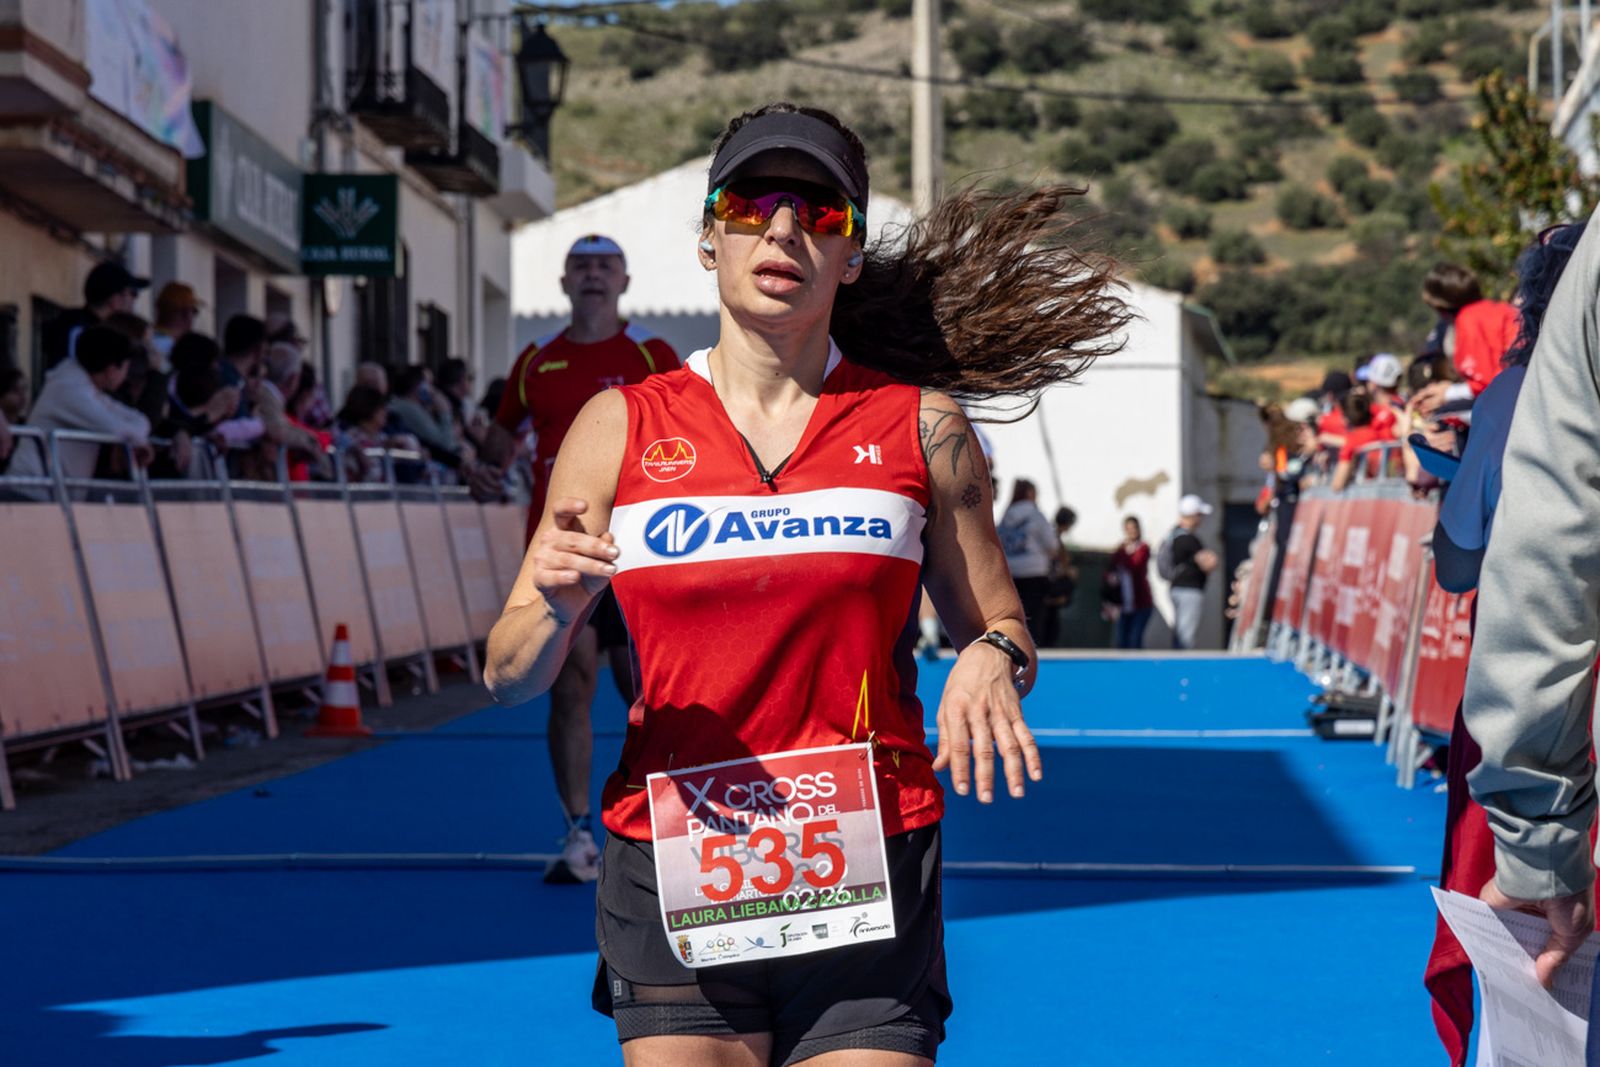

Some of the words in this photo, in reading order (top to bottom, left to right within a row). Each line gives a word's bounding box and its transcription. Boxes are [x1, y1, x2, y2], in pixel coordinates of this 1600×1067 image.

[713, 511, 892, 544] Avanza
[751, 507, 791, 518] GRUPO
[683, 776, 718, 816] X
[724, 772, 837, 810] CROSS
[686, 802, 814, 841] PANTANO
[818, 804, 840, 816] DEL
[699, 819, 846, 903] 535
[670, 905, 728, 928] LAURA
